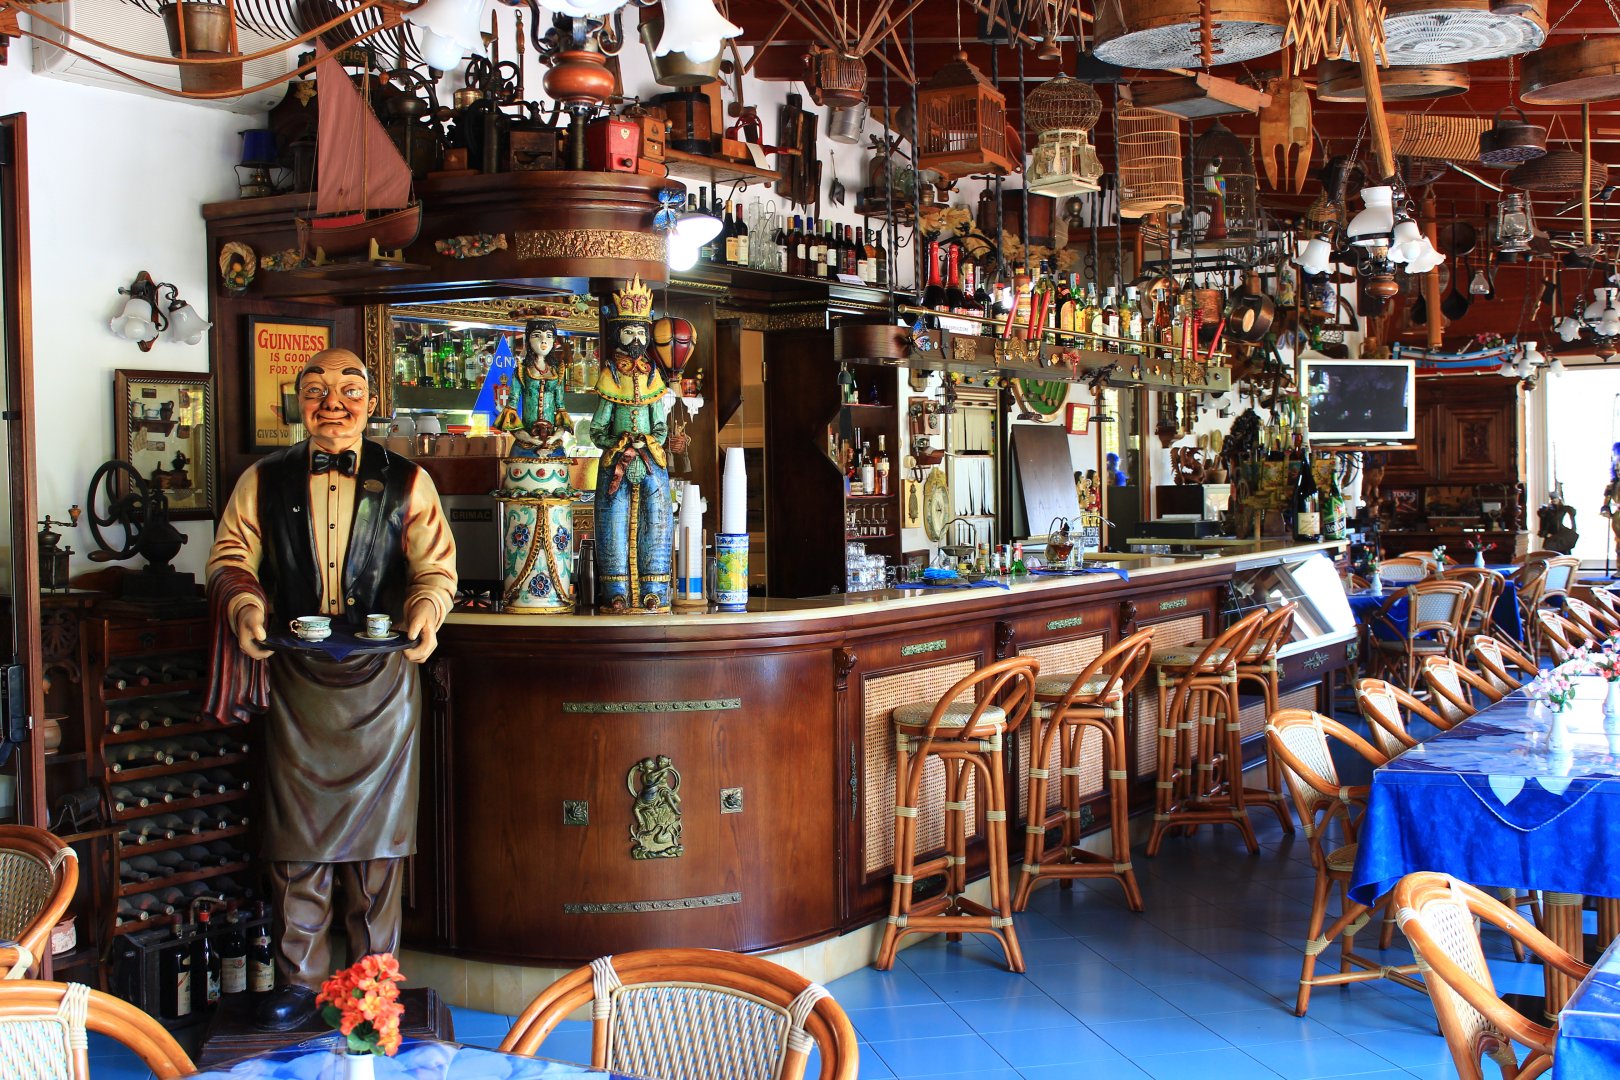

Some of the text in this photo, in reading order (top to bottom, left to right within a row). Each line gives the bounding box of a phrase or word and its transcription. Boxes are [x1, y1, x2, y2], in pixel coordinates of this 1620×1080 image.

[257, 329, 325, 351] GUINNESS
[270, 352, 311, 363] IS GOOD
[269, 365, 304, 375] FOR YO
[256, 429, 278, 439] GIVES
